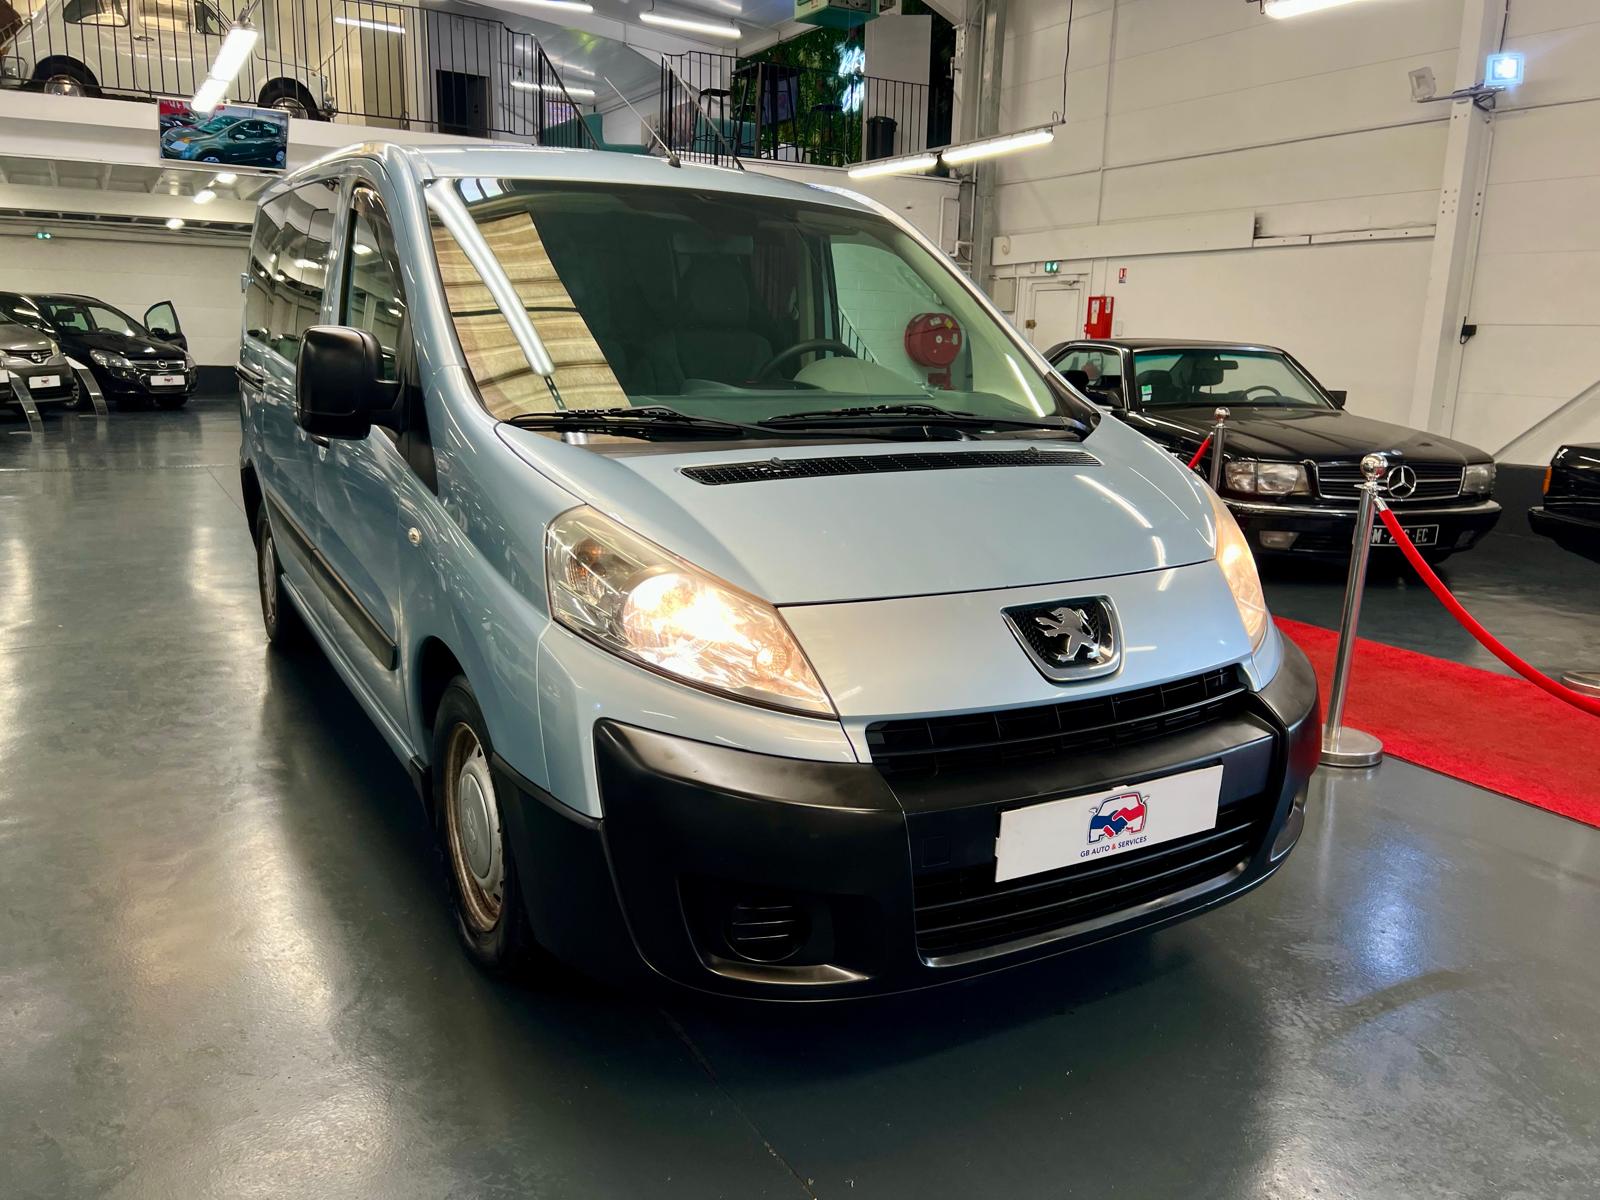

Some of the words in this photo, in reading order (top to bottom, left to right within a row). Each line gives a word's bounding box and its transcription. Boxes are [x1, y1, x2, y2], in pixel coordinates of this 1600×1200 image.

[1080, 849, 1090, 857] GB
[1091, 845, 1110, 854] AUTO
[1118, 836, 1147, 848] SERVICES
